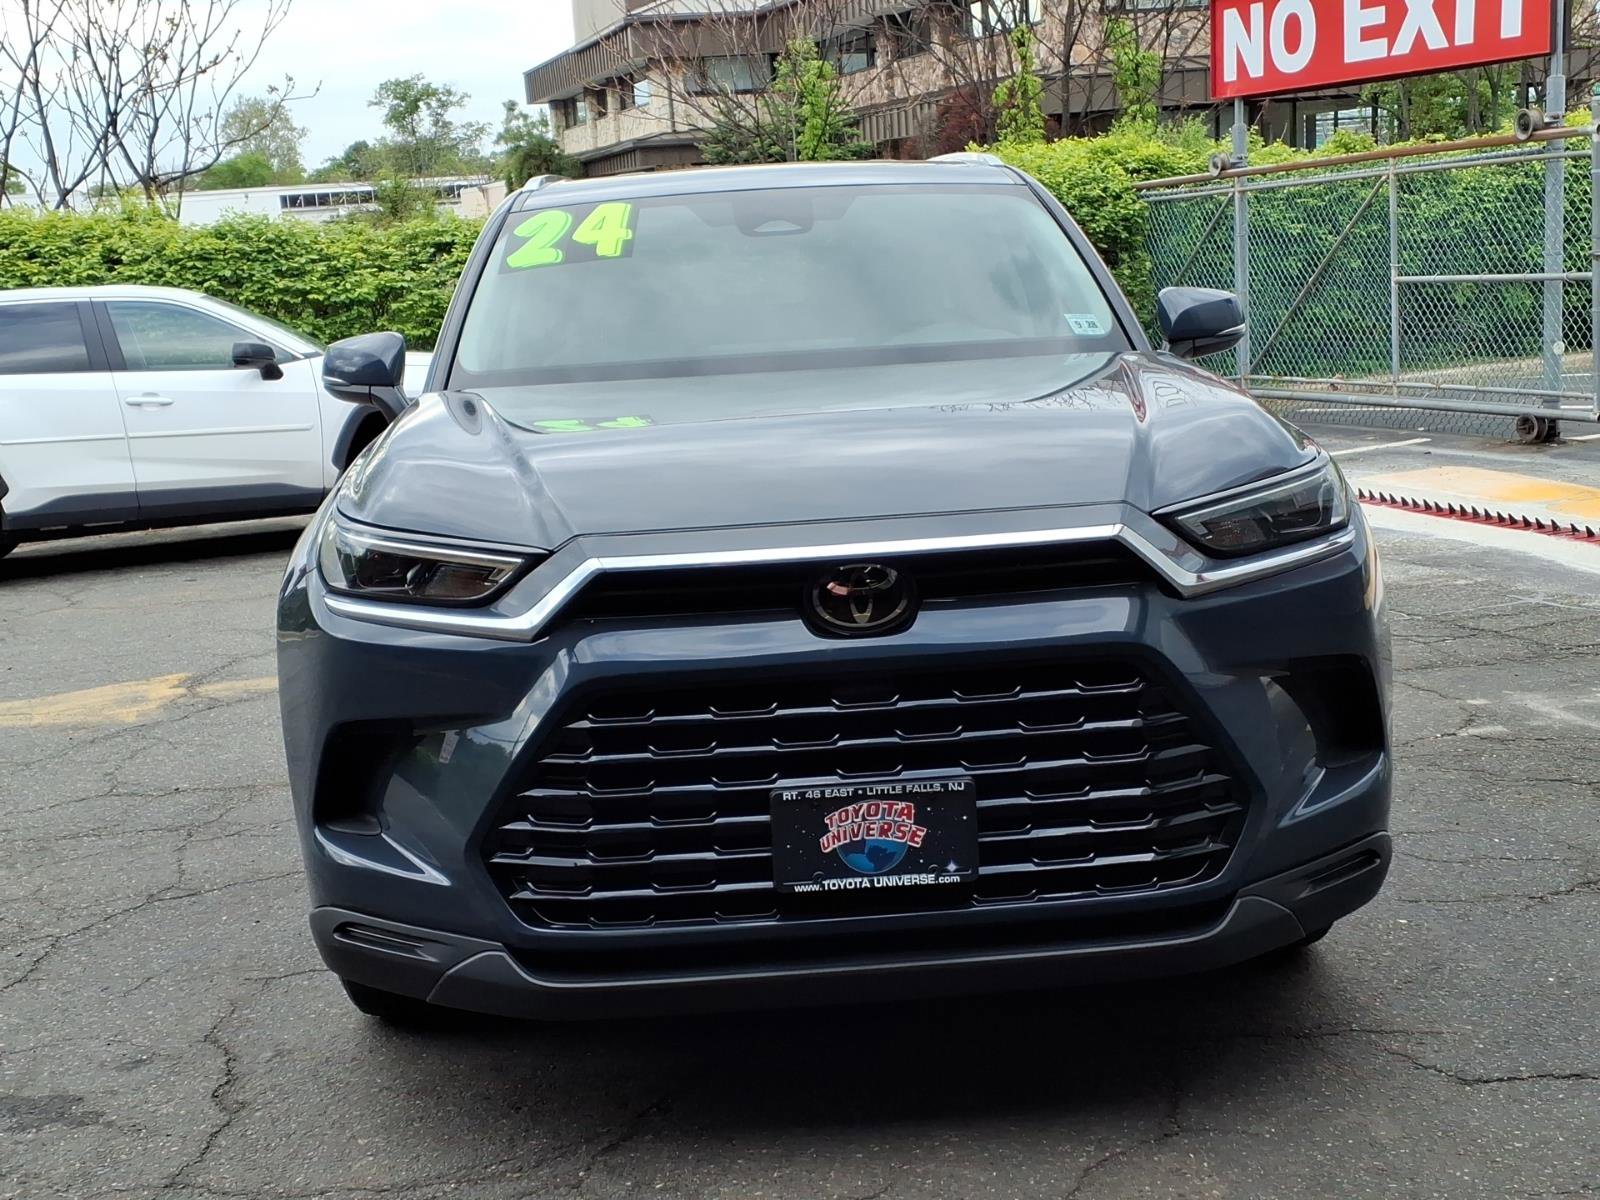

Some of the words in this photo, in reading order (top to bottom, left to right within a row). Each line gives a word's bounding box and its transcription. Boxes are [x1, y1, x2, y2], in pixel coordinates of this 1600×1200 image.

[1223, 0, 1316, 82] NO
[507, 203, 632, 268] 24
[783, 791, 801, 801] RT.
[825, 788, 854, 798] EAST
[867, 785, 902, 796] LITTLE
[906, 782, 944, 793] FALLS,
[949, 782, 965, 791] NJ
[825, 800, 914, 829] TOYOTA
[820, 820, 927, 853] UNIVERSE
